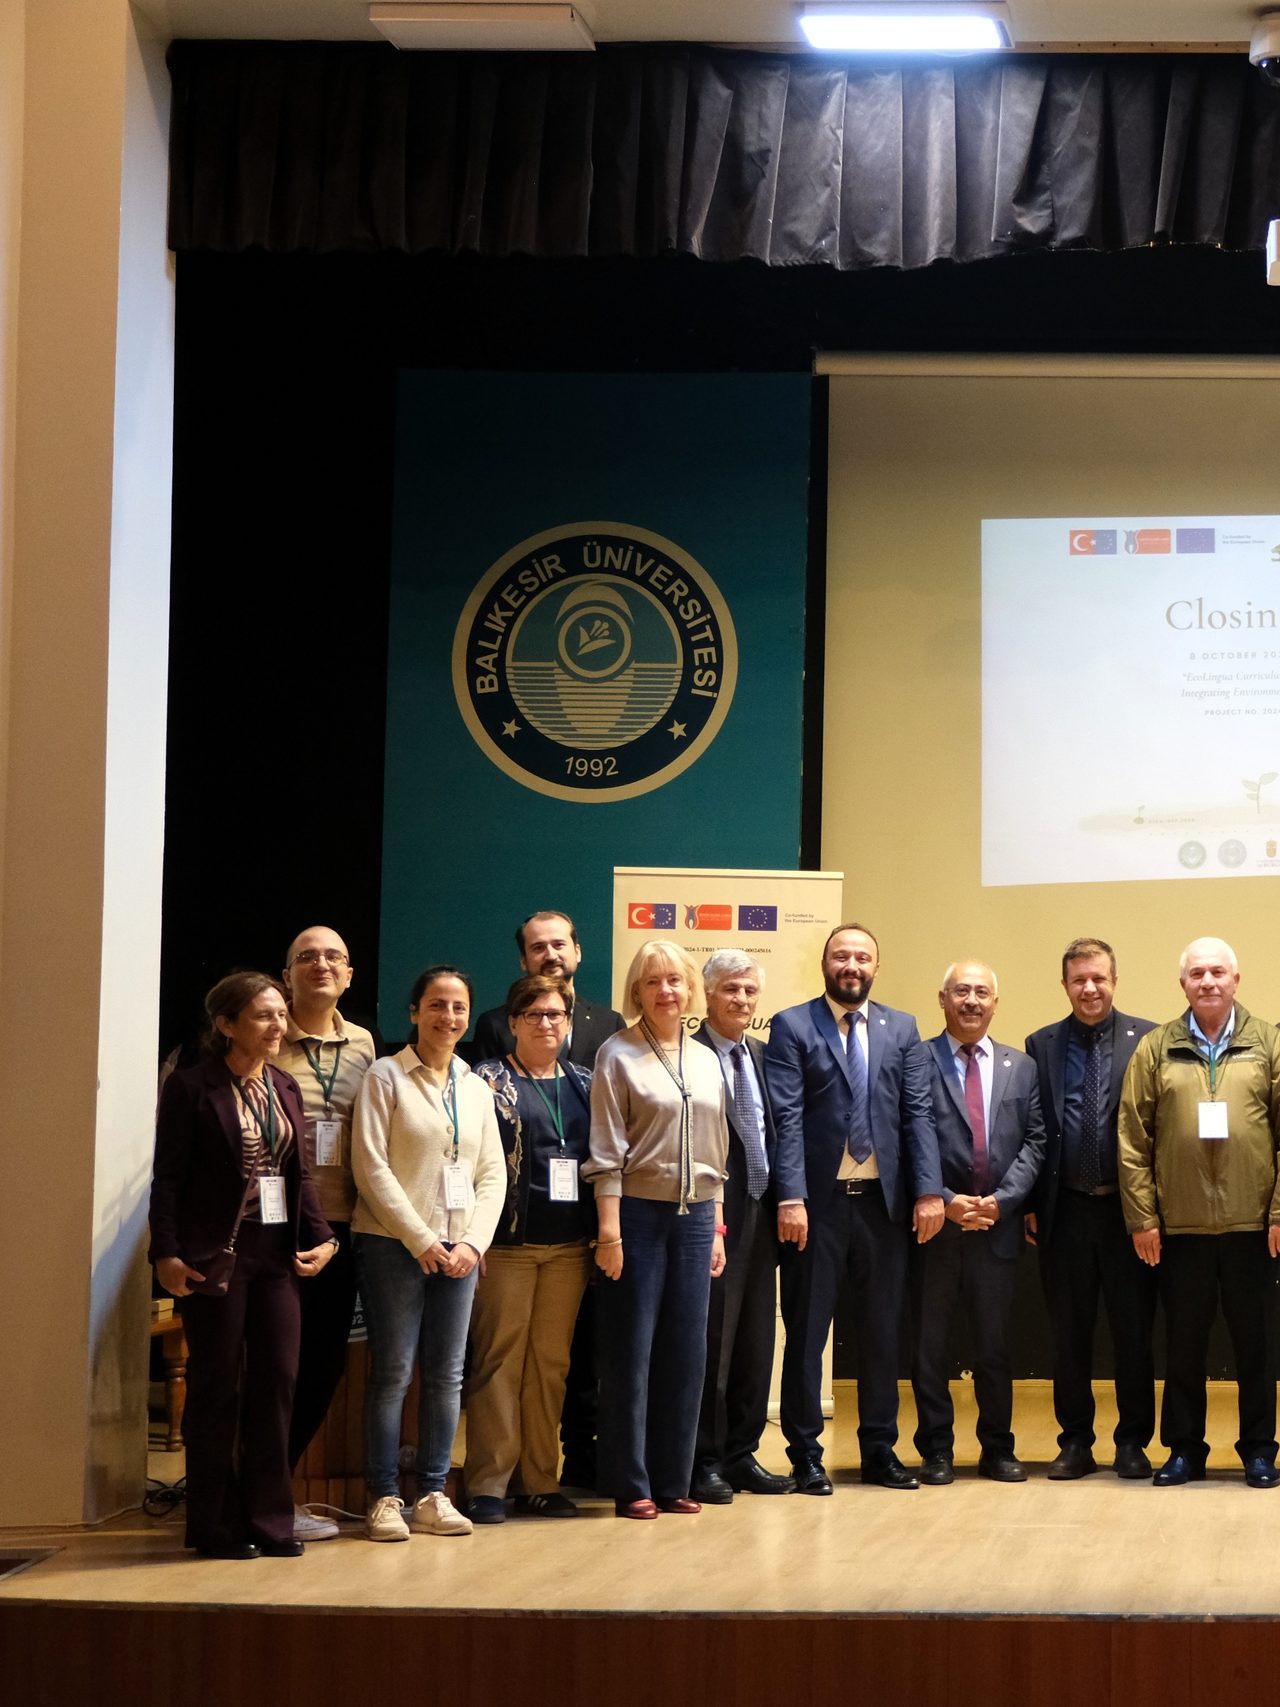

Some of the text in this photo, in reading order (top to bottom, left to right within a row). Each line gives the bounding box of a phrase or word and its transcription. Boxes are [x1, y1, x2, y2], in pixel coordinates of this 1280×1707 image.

[476, 541, 719, 699] BALIKESİR ÜNİVERSİTESİ
[1201, 651, 1257, 660] OCTOBER
[1181, 687, 1231, 701] Integrating
[564, 756, 620, 778] 1992
